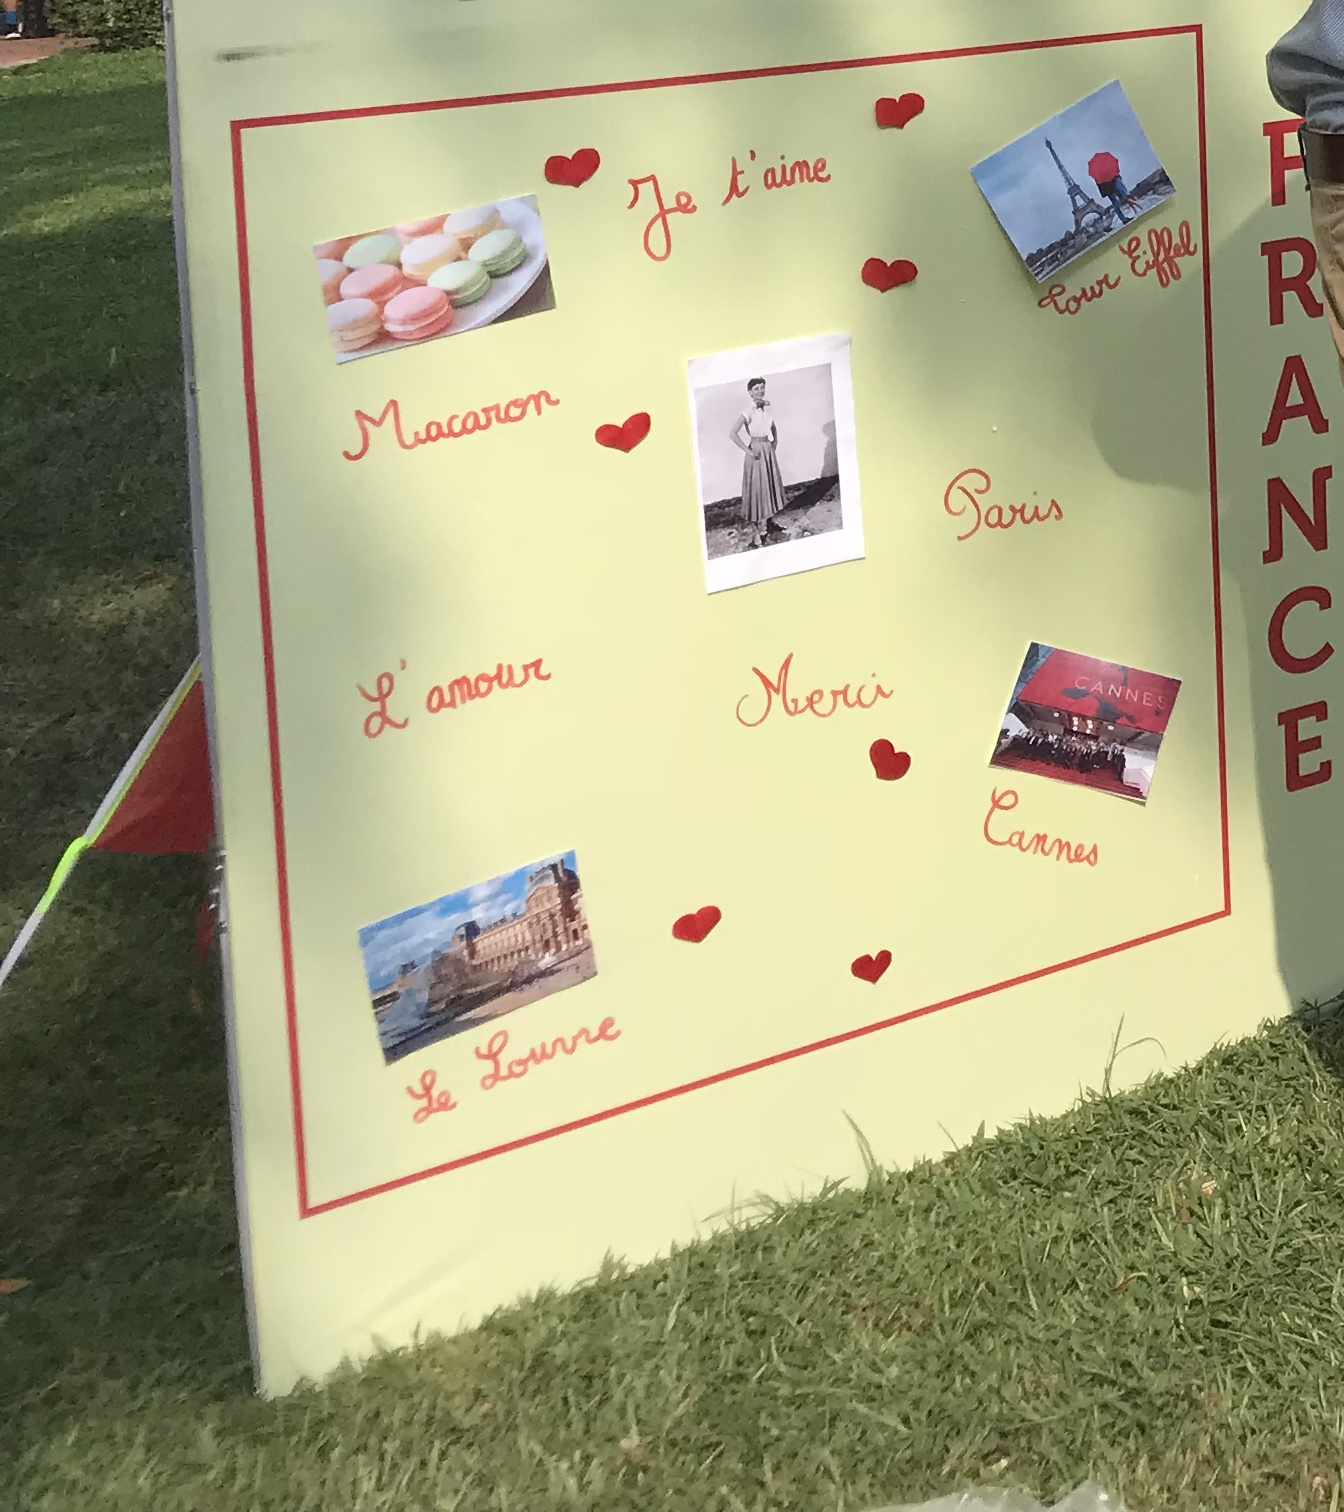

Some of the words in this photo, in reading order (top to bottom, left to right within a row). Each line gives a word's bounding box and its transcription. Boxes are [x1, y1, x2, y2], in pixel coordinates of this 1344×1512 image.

[627, 173, 698, 262] Je
[722, 150, 832, 206] t'aime
[1038, 274, 1120, 315] Tour
[1119, 221, 1198, 288] Eiffel
[342, 390, 560, 462] Macaron
[1260, 116, 1334, 792] FRANCE
[943, 467, 1064, 541] Paris
[736, 652, 894, 727] Merci
[1074, 675, 1167, 710] CANNES
[983, 789, 1099, 866] Cannes
[406, 1069, 458, 1123] Le
[474, 1017, 622, 1090] Louvre
